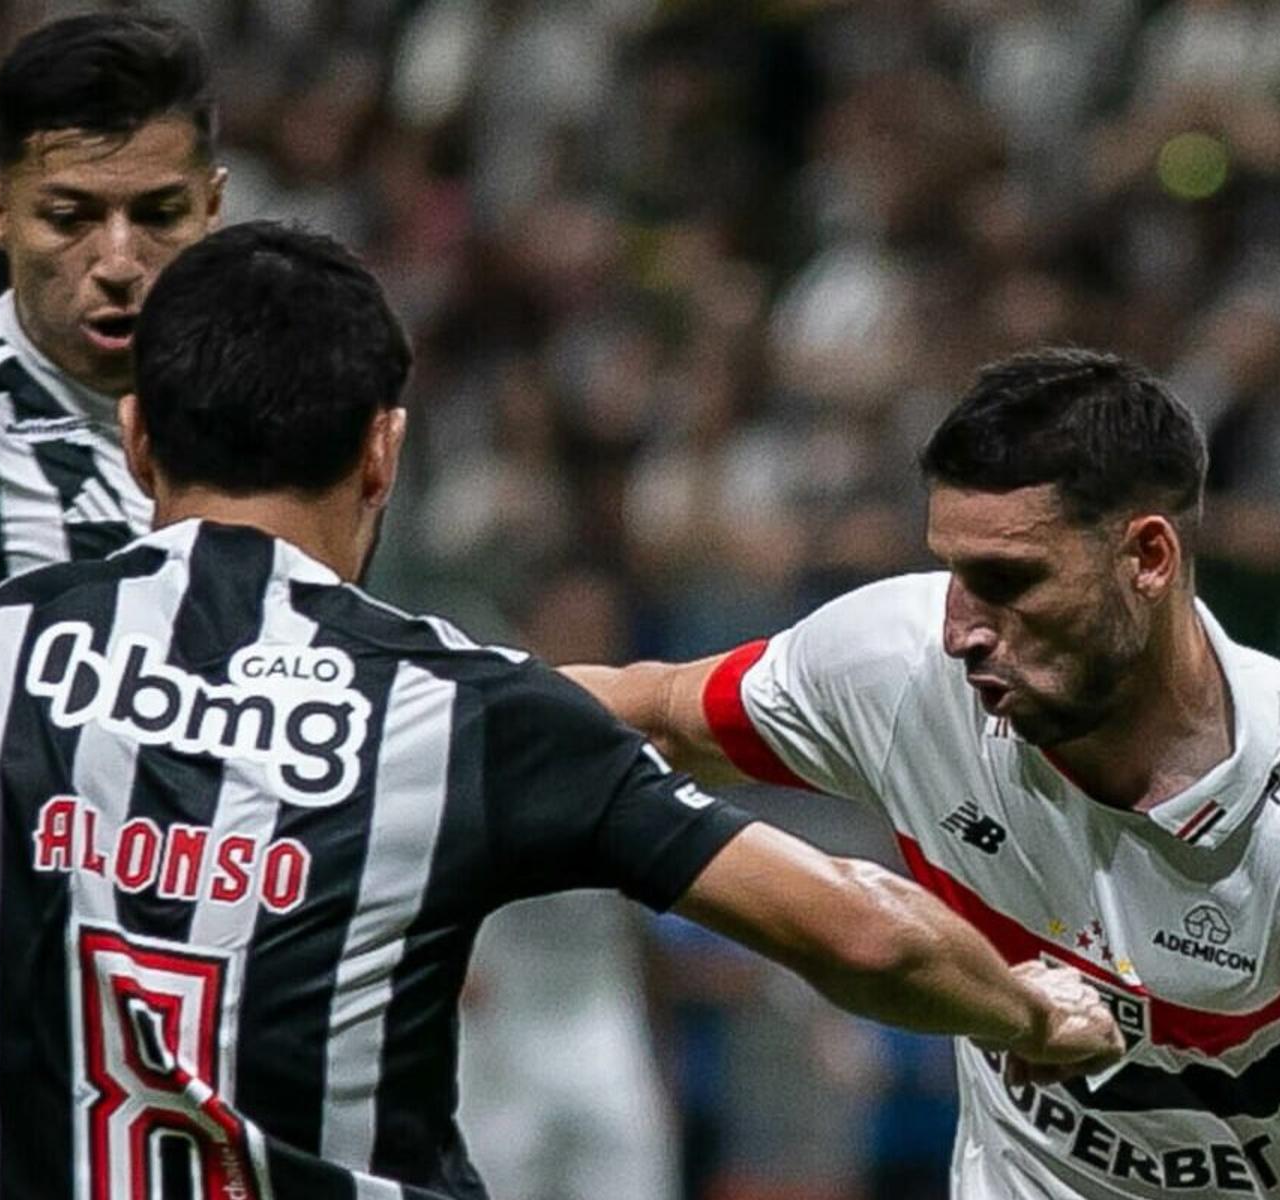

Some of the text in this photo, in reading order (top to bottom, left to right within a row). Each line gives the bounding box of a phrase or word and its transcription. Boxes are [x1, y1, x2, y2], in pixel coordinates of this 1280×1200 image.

[241, 655, 340, 683] GALO
[109, 643, 357, 794] bmg
[34, 797, 311, 913] ALONSO
[1152, 930, 1257, 973] ADEMICON
